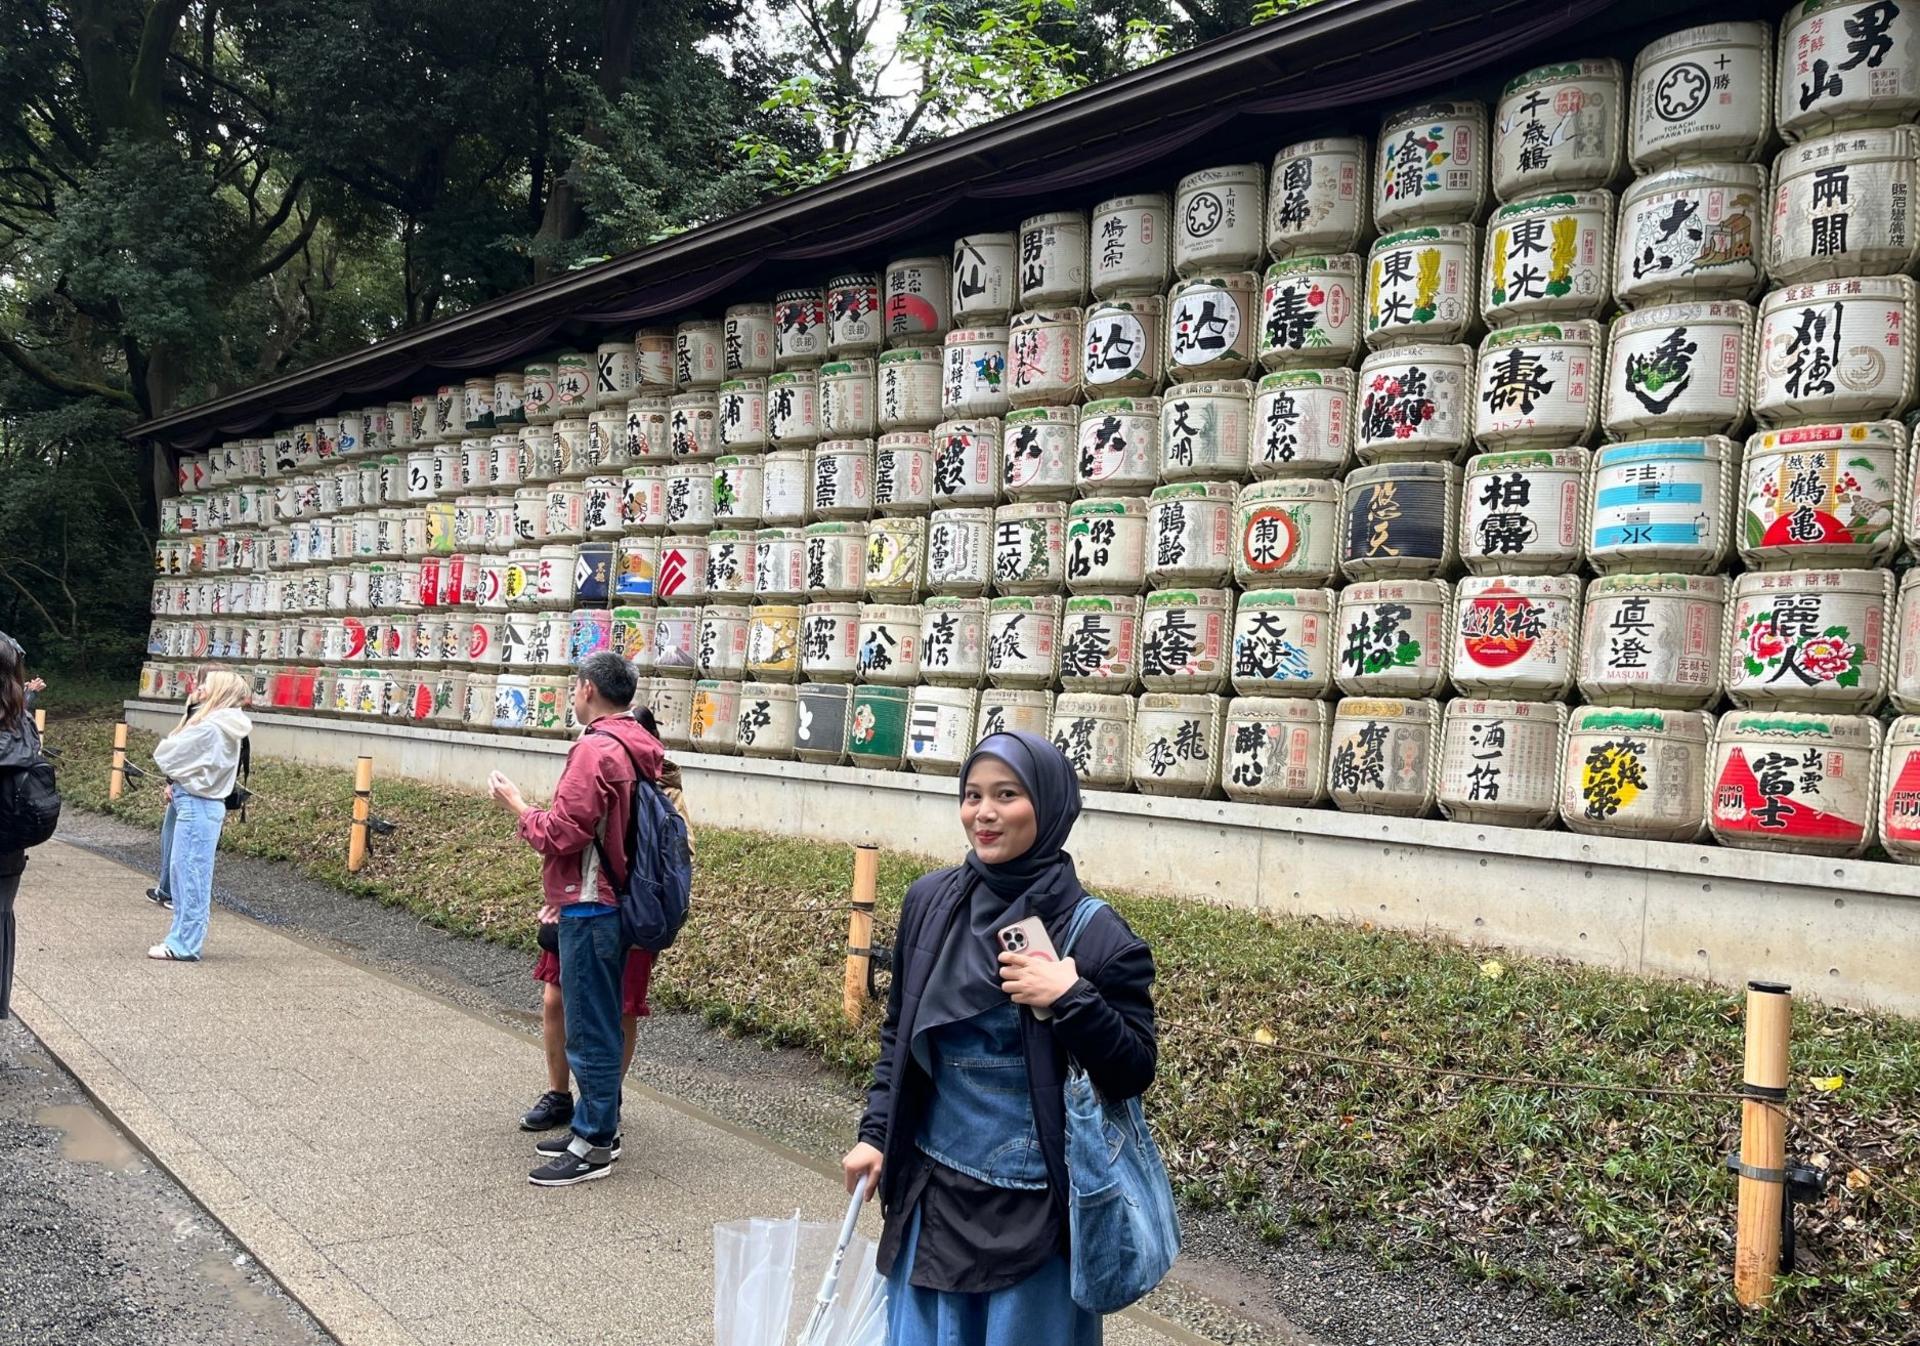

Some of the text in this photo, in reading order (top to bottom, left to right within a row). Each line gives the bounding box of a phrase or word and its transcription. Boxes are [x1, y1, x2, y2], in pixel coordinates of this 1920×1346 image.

[1713, 53, 1732, 90] 十勝
[1664, 120, 1697, 133] TOKACHI
[1682, 123, 1721, 138] TAISETSU
[1395, 131, 1424, 200] 金滴
[1225, 187, 1236, 229] 上川大雪
[1022, 230, 1044, 293] 男山
[1508, 219, 1548, 301] 東光
[1381, 250, 1414, 326] 東光
[1785, 282, 1862, 301] 登録商標
[725, 320, 743, 370] 日本盛
[1885, 310, 1902, 347] 清酒
[1569, 361, 1585, 398] 清酒
[1721, 336, 1738, 396] 秋田酒王
[1265, 391, 1300, 463] 奥の松
[1492, 418, 1536, 432] コトブキ
[1787, 453, 1827, 471] 越後
[1480, 471, 1532, 555] 柏露
[997, 521, 1021, 578] 王紋
[1253, 517, 1280, 565] 菊水
[1761, 573, 1840, 587] 登録商標
[1608, 596, 1655, 668] 真澄
[1765, 594, 1825, 687] 麗人
[1606, 670, 1649, 681] MASUMI
[1467, 721, 1505, 801] 酒一筋
[1799, 748, 1823, 794] 出雲
[1718, 793, 1744, 809] FUJI
[1751, 752, 1799, 828] 富士
